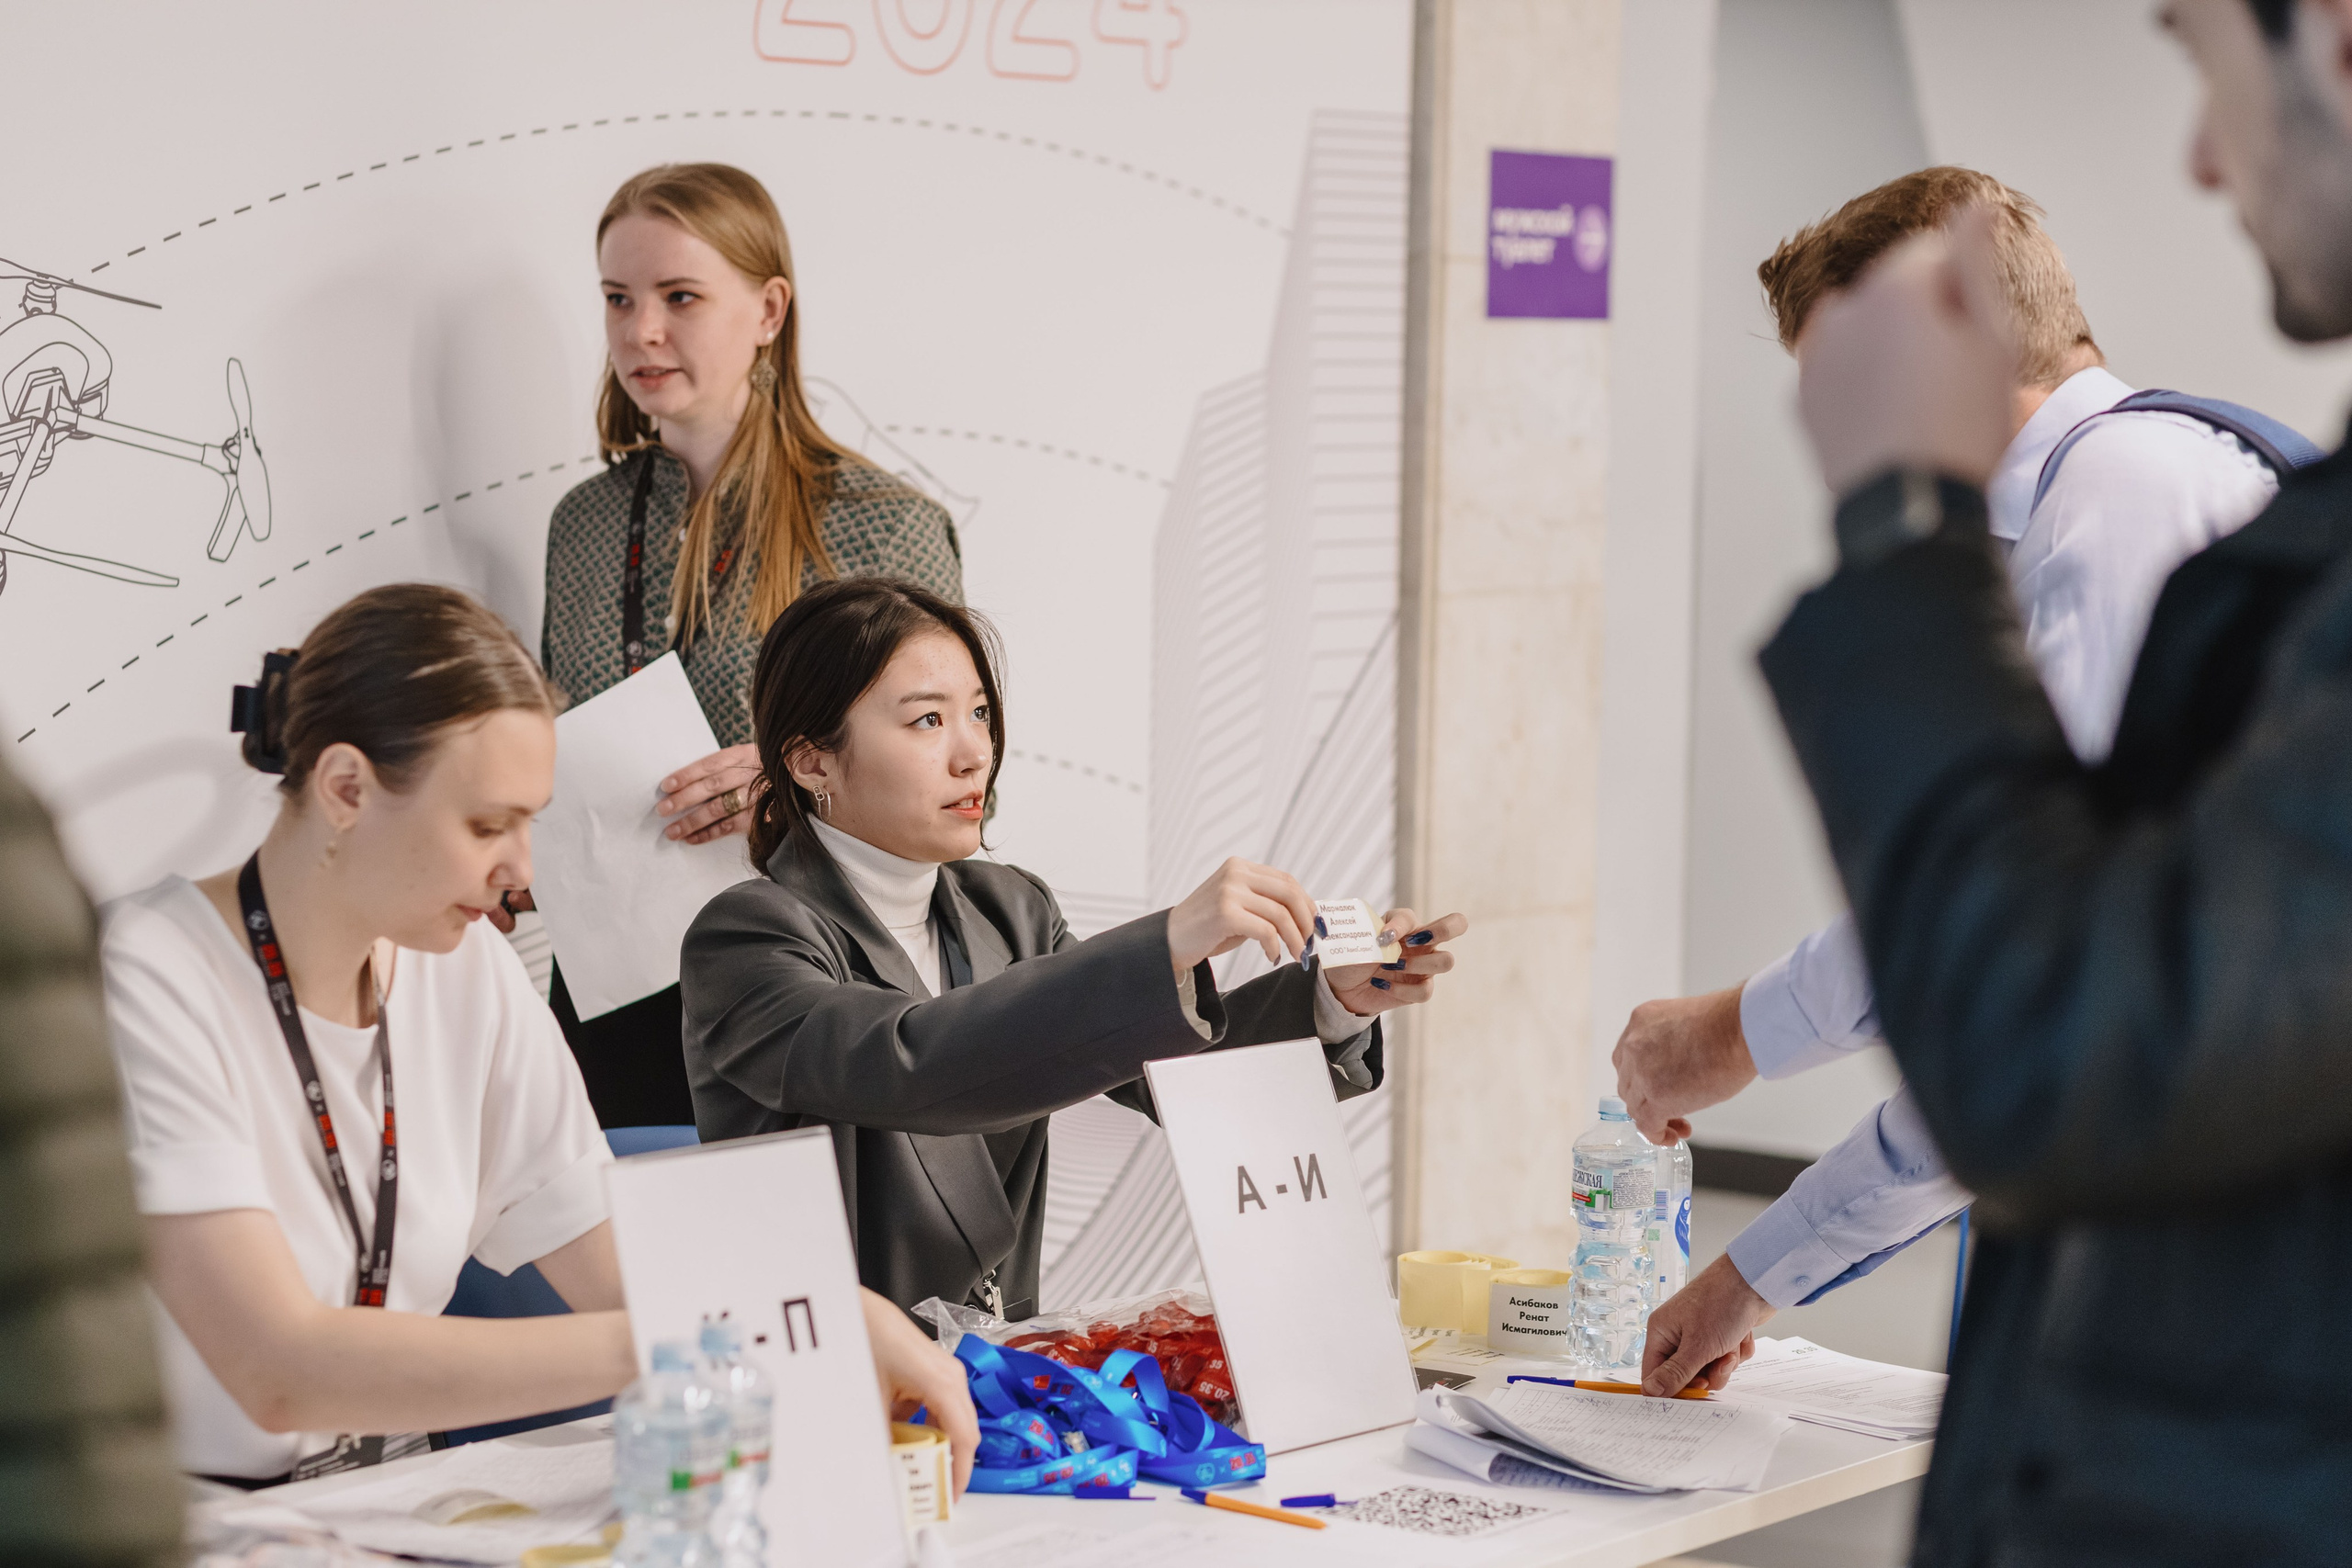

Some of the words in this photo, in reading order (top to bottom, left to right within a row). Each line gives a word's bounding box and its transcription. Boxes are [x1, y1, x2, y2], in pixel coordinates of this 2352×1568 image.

[1324, 931, 1373, 942] лександрович
[1509, 1296, 1559, 1310] Асибаков
[1519, 1311, 1550, 1323] Ренат
[1501, 1322, 1567, 1337] Исмагилович
